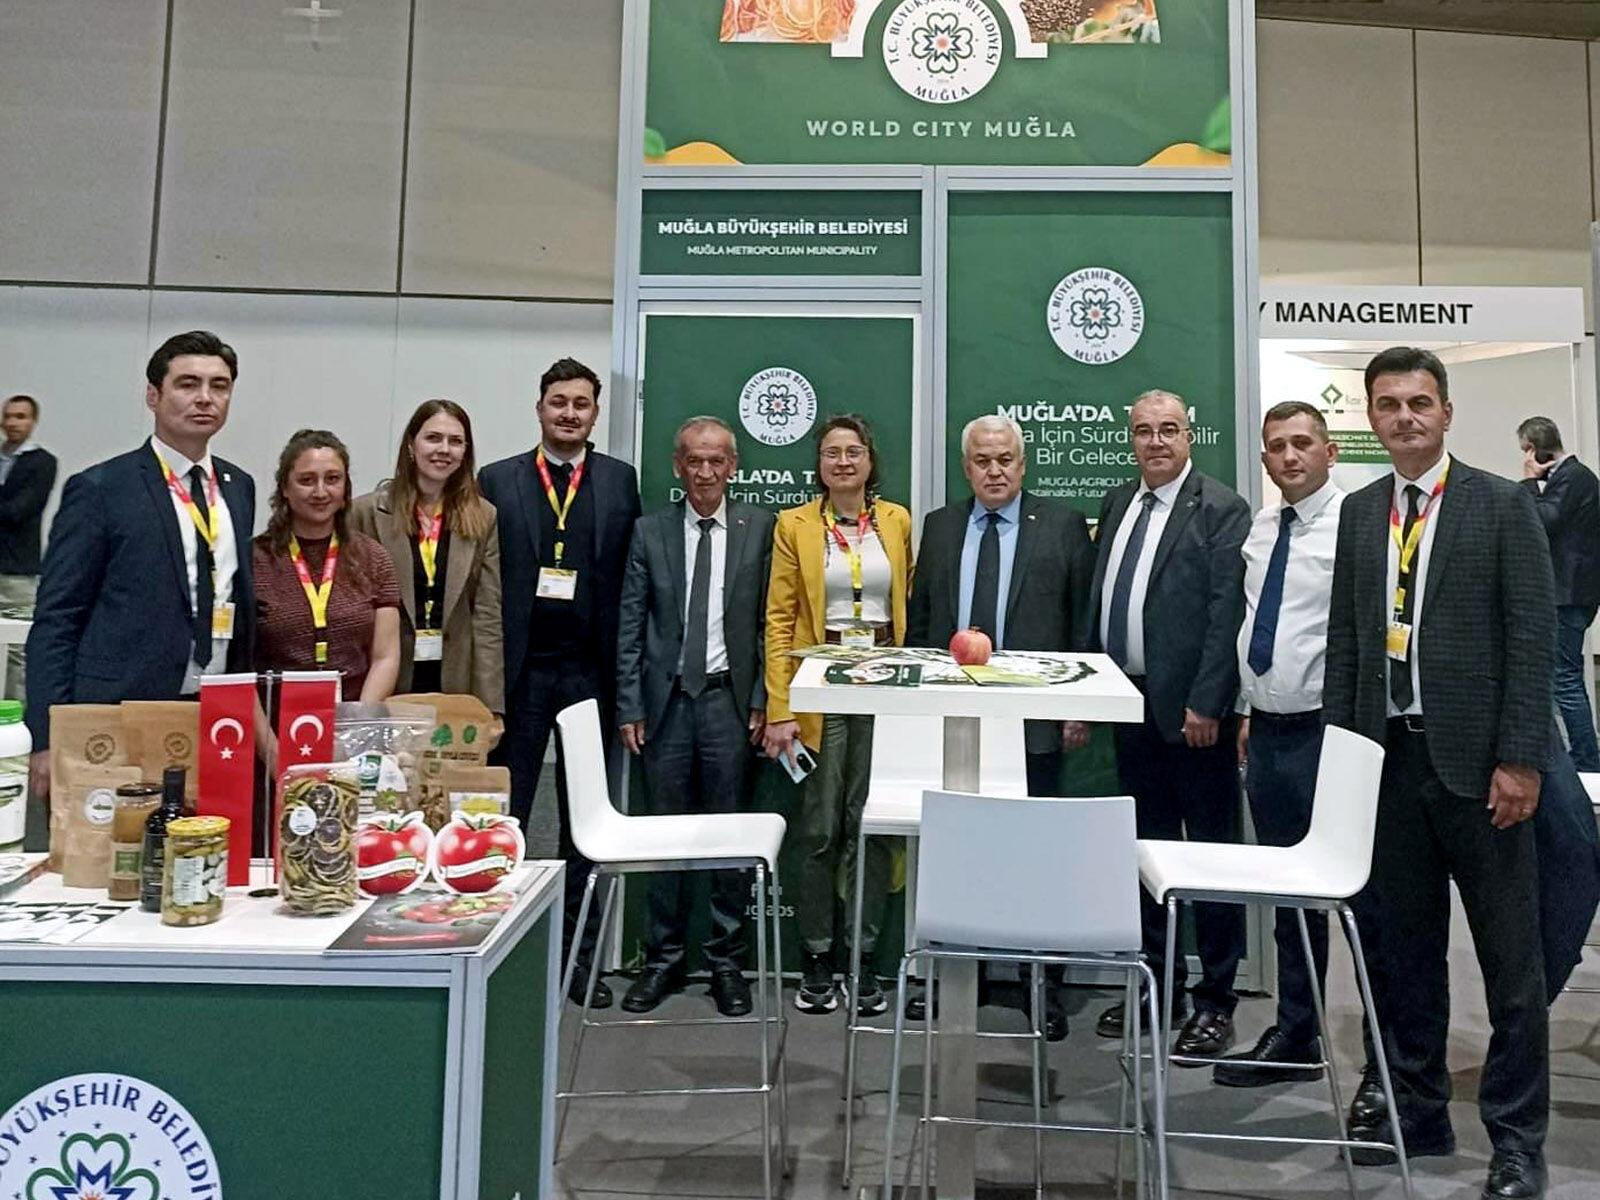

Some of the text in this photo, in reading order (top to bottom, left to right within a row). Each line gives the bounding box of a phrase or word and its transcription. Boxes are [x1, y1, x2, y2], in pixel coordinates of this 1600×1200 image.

[806, 117, 1077, 137] WORLD CITY MUĞLA
[658, 218, 909, 238] MUĞLA BÜYÜKŞEHİR BELEDİYESİ
[687, 244, 878, 256] MUĞLA METROPOLITAN MUNICIPALITY
[1275, 302, 1473, 324] MANAGEMENT
[1041, 423, 1076, 447] İçin
[1036, 447, 1139, 466] Bir Gelece
[0, 1079, 218, 1200] ÜYÜKŞEHİR BELEDİ
